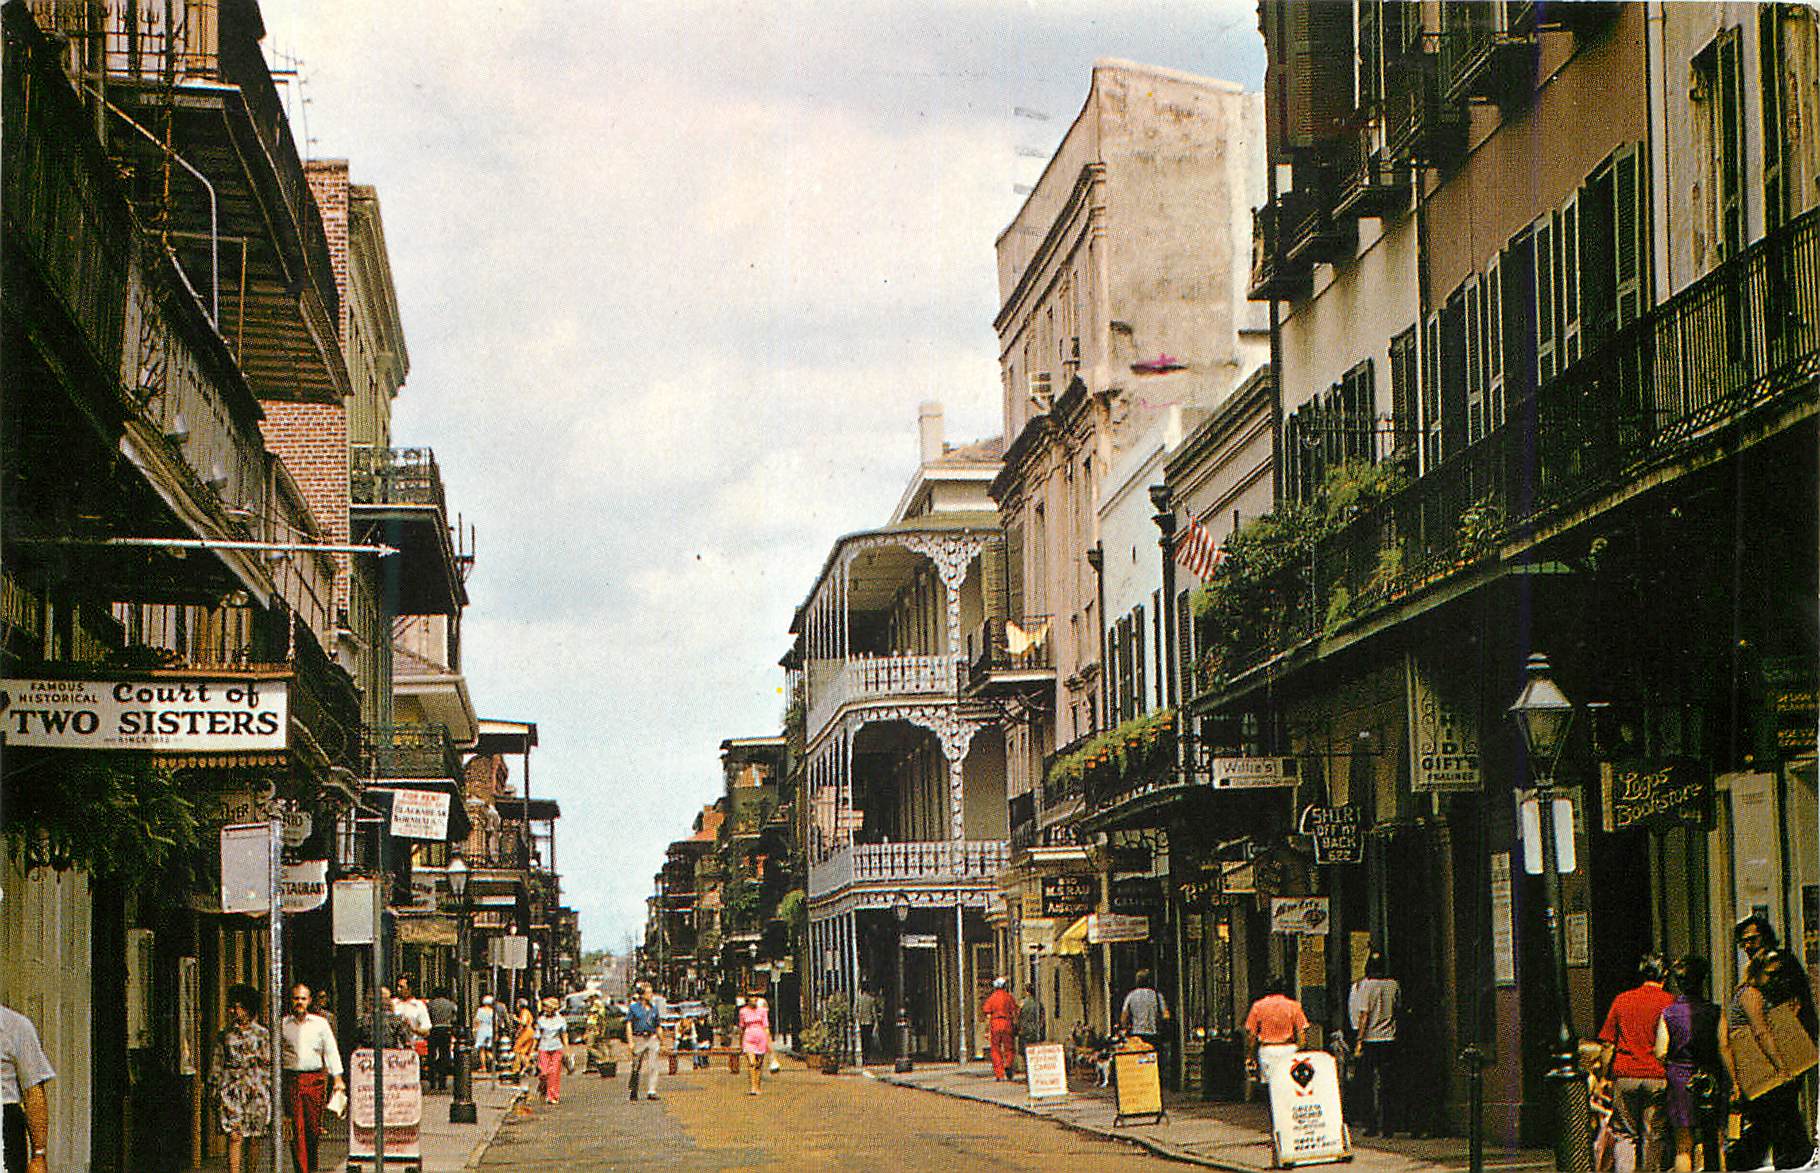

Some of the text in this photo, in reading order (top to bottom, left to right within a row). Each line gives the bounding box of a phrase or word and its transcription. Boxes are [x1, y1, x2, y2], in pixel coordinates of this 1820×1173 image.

[30, 682, 84, 692] FAMOUS
[19, 693, 98, 704] HISTORICAL
[112, 681, 260, 709] Court of
[9, 709, 280, 736] TWO SISTERS
[1614, 782, 1703, 827] Bookstore
[1316, 824, 1338, 836] OFF
[1321, 836, 1357, 849] BACK
[1328, 850, 1351, 861] 622
